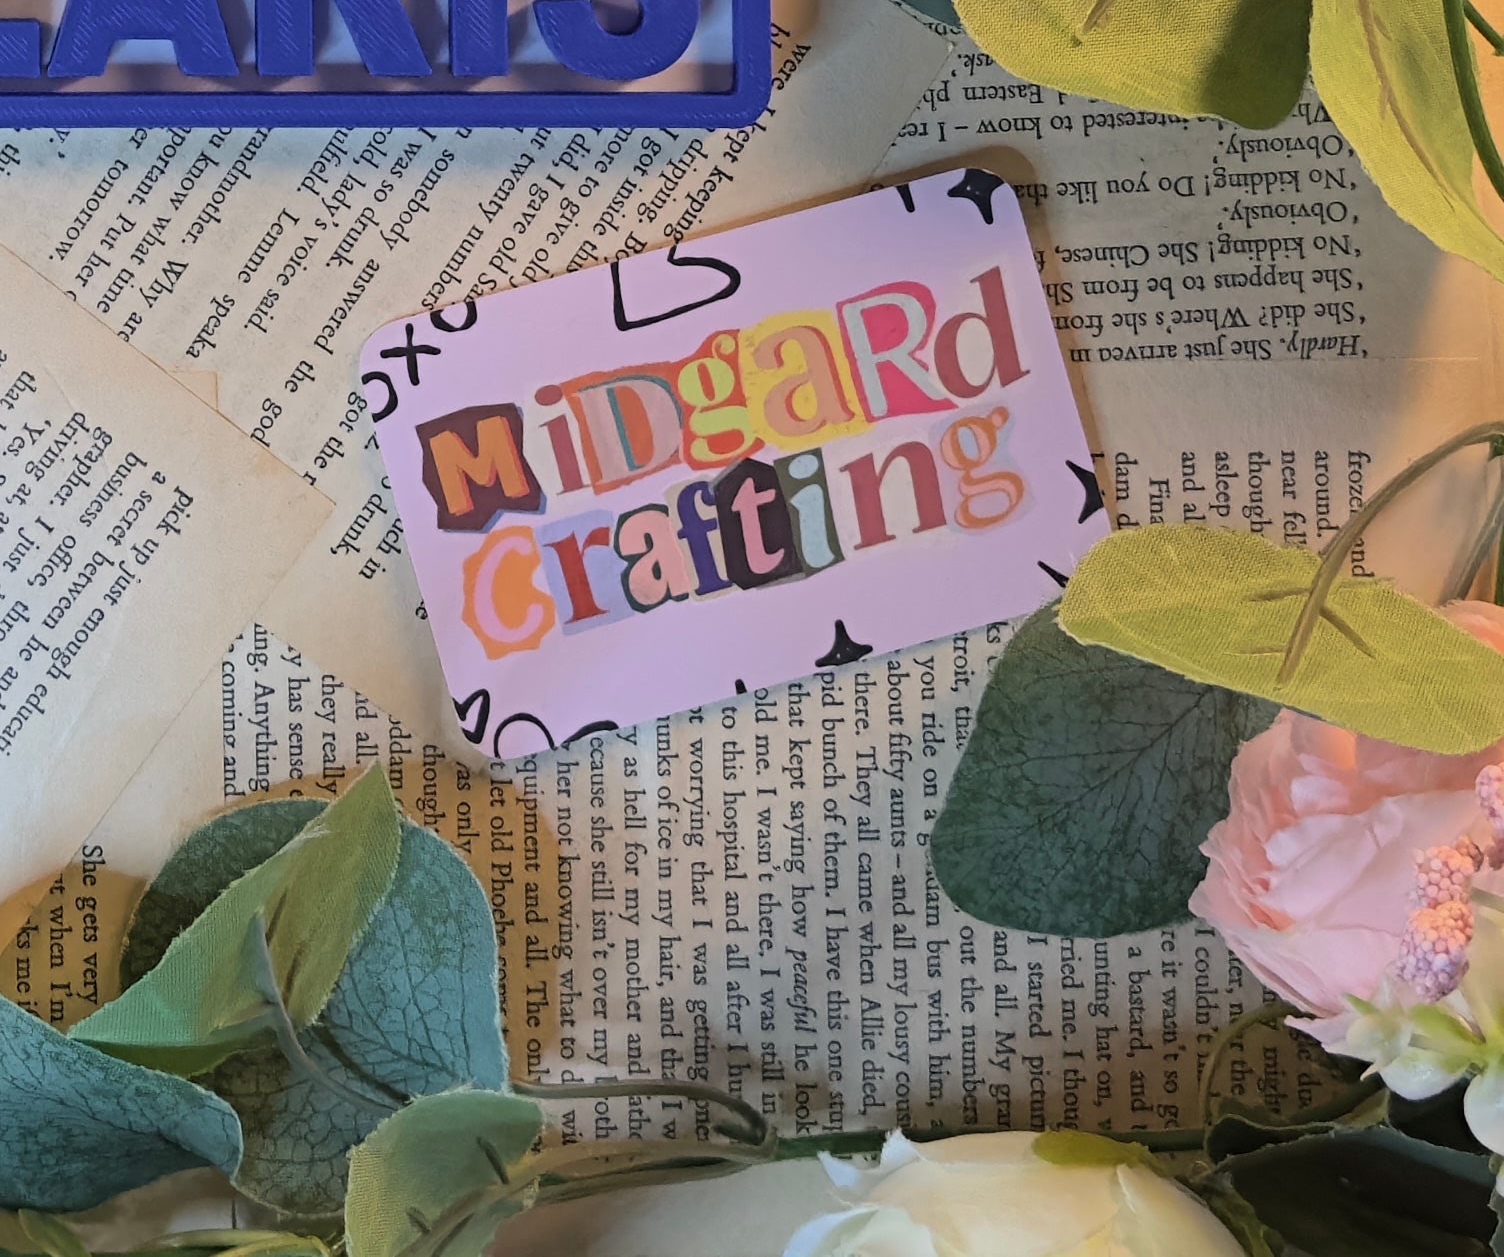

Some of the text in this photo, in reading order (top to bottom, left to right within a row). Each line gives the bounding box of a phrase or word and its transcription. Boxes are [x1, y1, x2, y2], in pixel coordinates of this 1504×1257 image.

[961, 81, 1044, 104] Eastern
[48, 158, 129, 261] tomorrow.
[275, 235, 319, 286] voice
[283, 148, 455, 393] somebody answered the
[1053, 243, 1150, 267] Chinese,
[1156, 240, 1200, 266] She
[1206, 233, 1306, 263] kidding!
[184, 206, 300, 358] Lemme speaka
[1080, 278, 1139, 301] from
[1145, 275, 1175, 300] be
[1181, 274, 1206, 292] to
[1212, 264, 1306, 294] happens
[243, 287, 280, 333] said.
[1114, 451, 1139, 501] dam
[1207, 450, 1238, 517] asleep
[1280, 449, 1297, 500] near
[1313, 449, 1337, 538] around.
[154, 485, 194, 536] pick
[464, 407, 1025, 651] Crafting
[129, 537, 159, 566] up
[102, 559, 141, 606] just
[45, 607, 105, 680] enough
[853, 671, 877, 736] there.
[247, 679, 278, 793] Anything
[313, 673, 346, 794] they really
[849, 745, 879, 807] They
[856, 815, 881, 843] all
[782, 681, 817, 1072] that kept saying how peaceful he
[857, 851, 873, 914] came
[48, 904, 71, 970] when
[74, 844, 105, 1005] She gets very
[682, 736, 713, 1082] worrying that I was getting
[857, 919, 881, 986] when
[859, 994, 882, 1051] Allie
